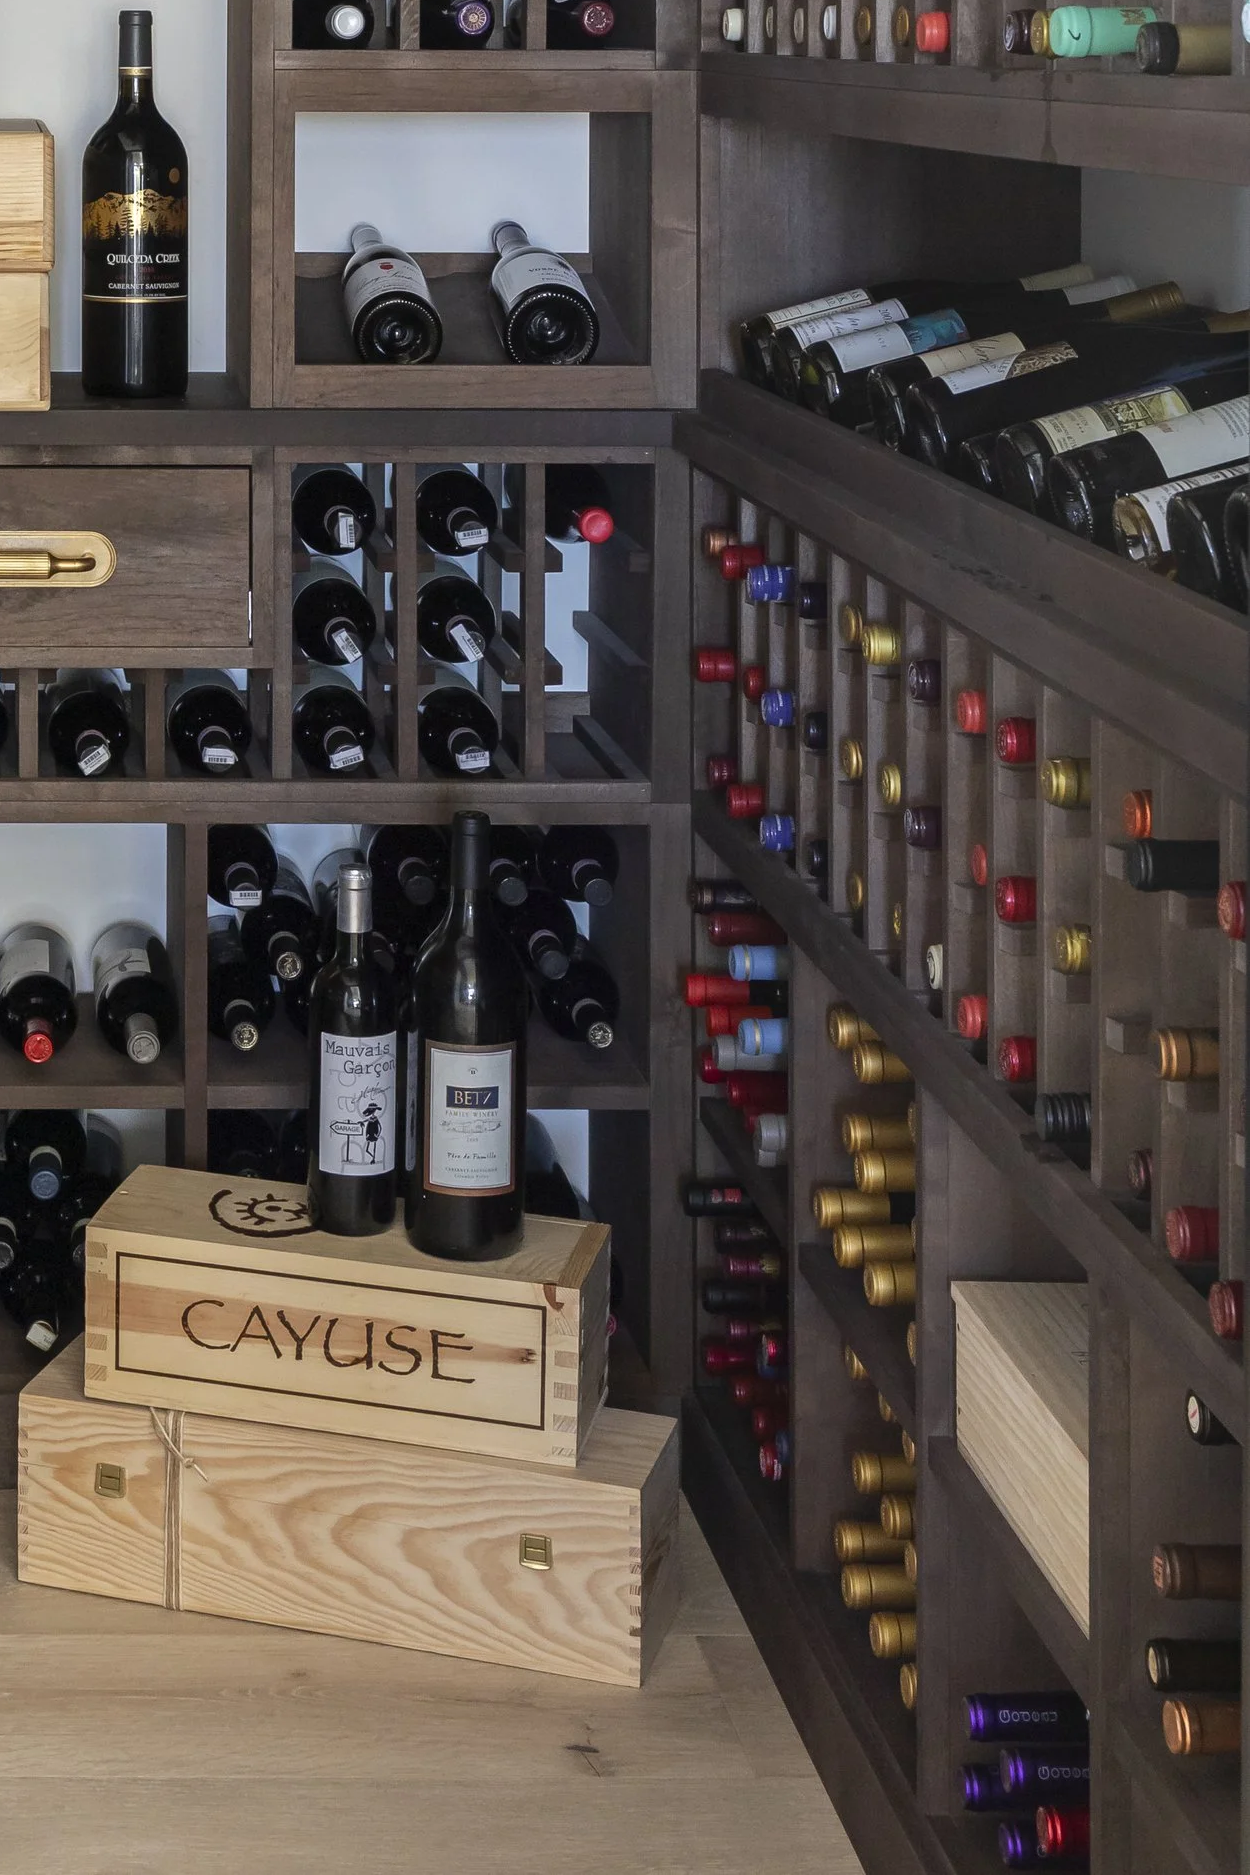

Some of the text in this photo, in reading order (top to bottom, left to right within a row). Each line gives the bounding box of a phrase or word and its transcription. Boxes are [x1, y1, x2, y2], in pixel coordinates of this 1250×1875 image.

[156, 253, 180, 263] CREEK
[108, 282, 180, 290] CABERNET SAUVIGNON
[325, 1039, 390, 1057] Mauvais
[343, 1059, 395, 1078] Garçon
[454, 1090, 492, 1106] BETZ
[334, 1125, 361, 1133] GARAGE
[181, 1299, 476, 1384] CAYUSE
